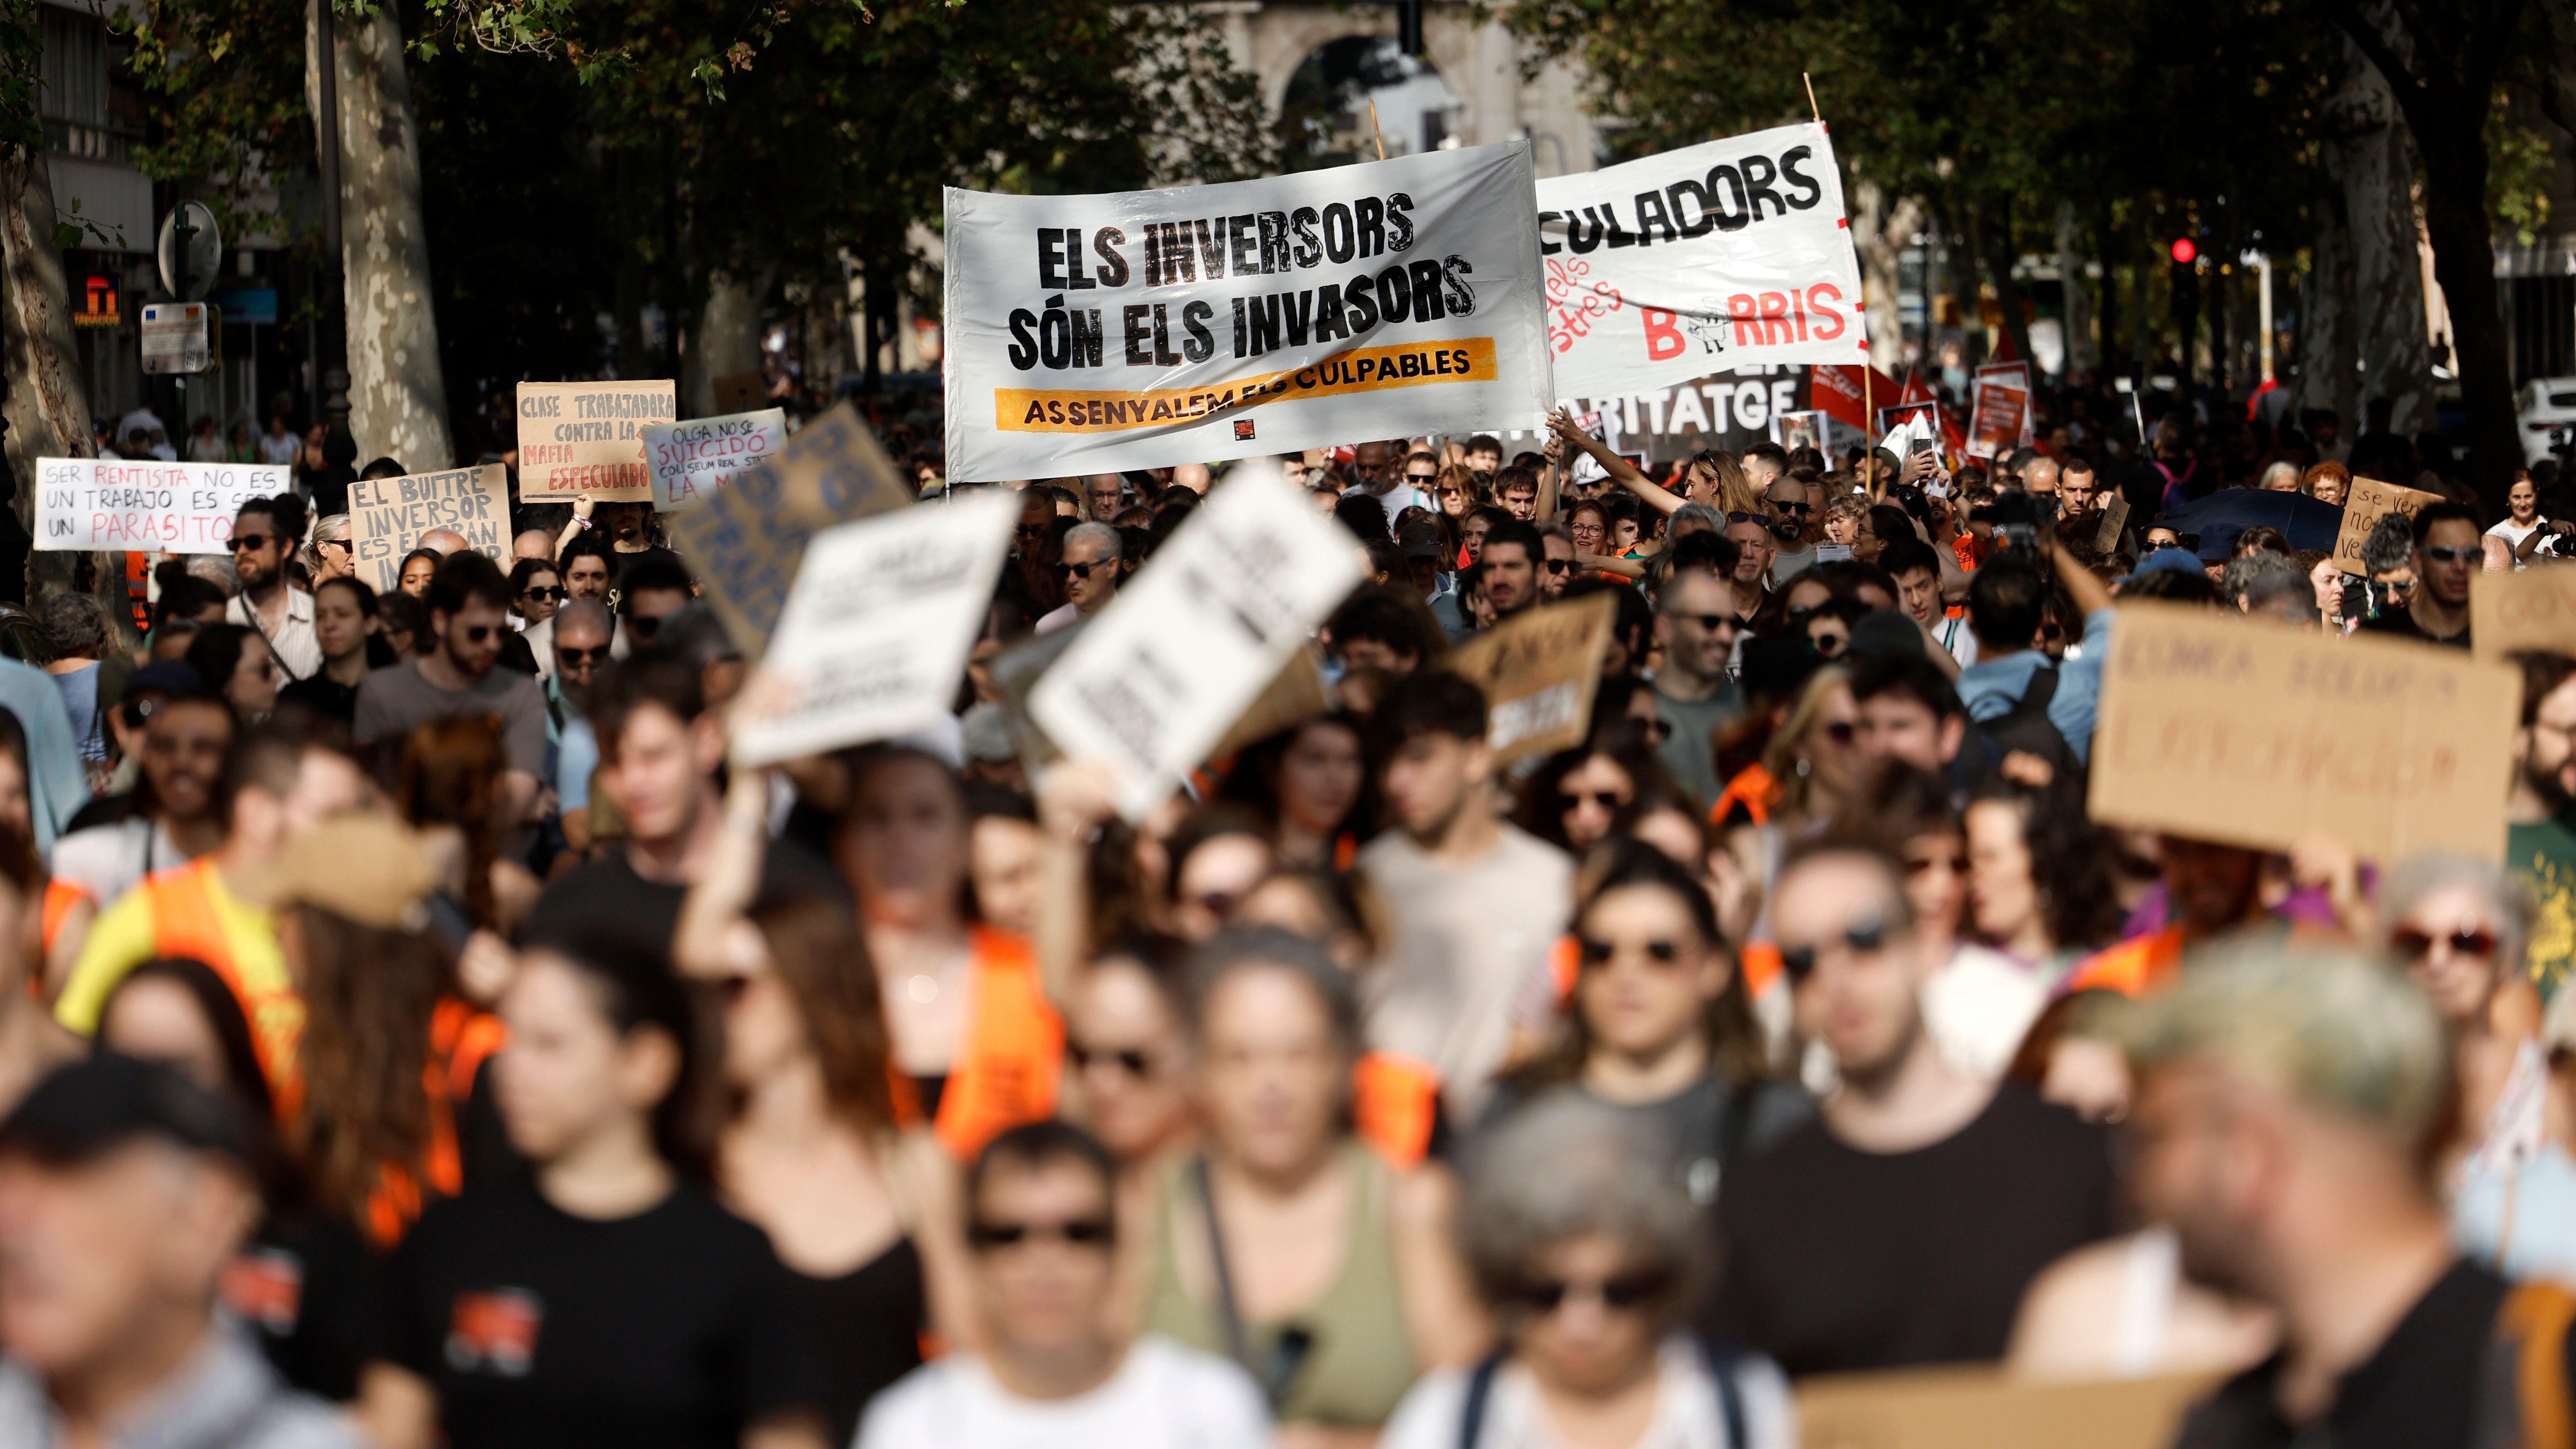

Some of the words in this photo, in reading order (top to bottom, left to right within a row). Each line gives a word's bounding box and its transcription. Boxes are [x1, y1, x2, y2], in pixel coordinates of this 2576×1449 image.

[1537, 146, 1821, 255] CULADORS
[1038, 225, 1128, 290] ELS
[1144, 192, 1414, 288] INVERSORS
[1008, 294, 1103, 371] SÓN
[1124, 300, 1215, 368] ELS
[1232, 254, 1476, 358] INVASORS
[1550, 282, 1622, 364] stres
[1024, 388, 1234, 426] ASSENYALEM
[1295, 349, 1470, 389] CULPABLES
[520, 395, 561, 418] CLASE
[574, 393, 674, 419] TRABAJADORA
[554, 421, 612, 442] CONTRA
[619, 421, 635, 440] LA
[673, 425, 711, 445] OLGA
[719, 422, 735, 437] NO
[741, 419, 754, 435] SE
[524, 444, 574, 466] MAFIA
[657, 427, 768, 466] SUICIDÓ
[45, 465, 82, 484] SER
[94, 465, 190, 488] RENTISTA
[204, 469, 234, 489] NO
[250, 472, 276, 489] ES
[549, 463, 648, 490] ESPECULADO
[718, 460, 738, 468] REAL
[46, 490, 73, 509] UN
[85, 489, 171, 510] TRABAJO
[193, 491, 217, 510] ES
[353, 481, 388, 508] EL
[397, 468, 486, 503] BUITRE
[669, 476, 699, 503] LA
[2357, 491, 2382, 505] se
[49, 517, 73, 537] UN
[92, 513, 234, 544] PARASITO
[365, 494, 492, 537] INVERSOR
[2350, 511, 2372, 531] no
[358, 538, 391, 561] ES
